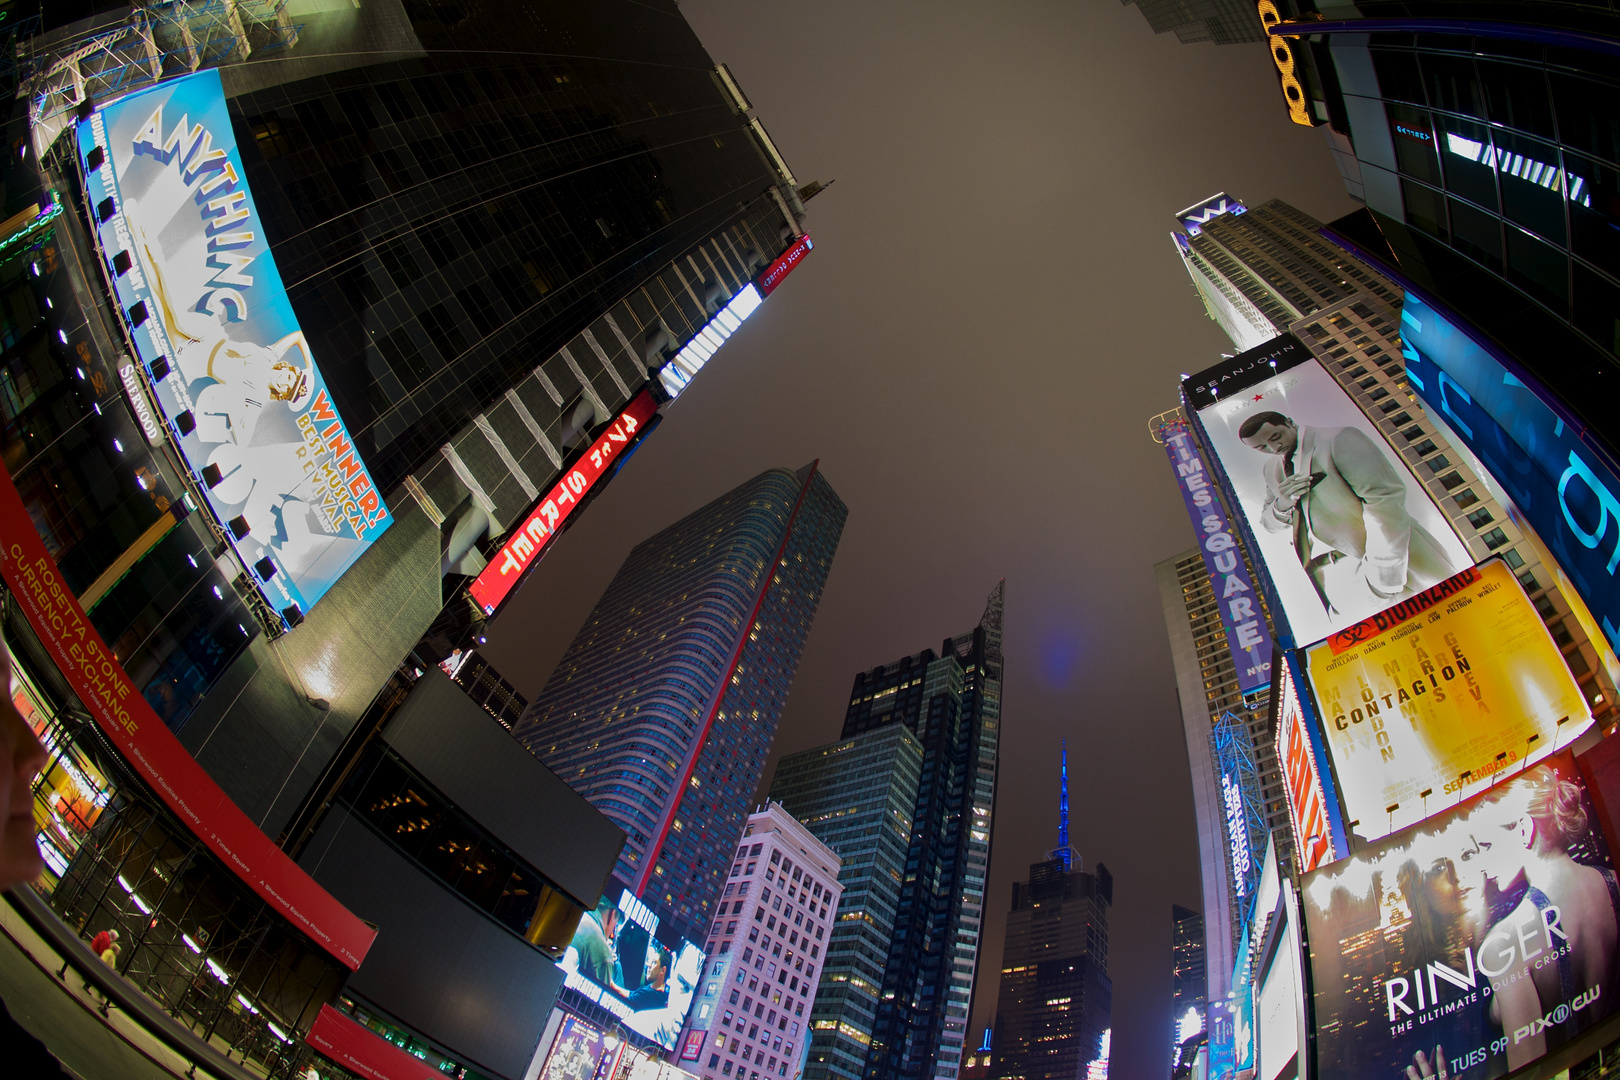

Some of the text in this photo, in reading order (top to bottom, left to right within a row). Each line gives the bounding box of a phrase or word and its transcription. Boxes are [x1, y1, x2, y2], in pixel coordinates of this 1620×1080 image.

[133, 104, 256, 326] ANYTHING
[1185, 199, 1227, 223] W
[119, 363, 159, 442] SHERWOOD
[295, 412, 368, 541] BEST MUSICAL
[295, 446, 346, 534] REVIVAL
[310, 388, 388, 530] WINNER!
[500, 470, 588, 577] STREET
[1201, 513, 1263, 650] SQUARE
[1374, 567, 1476, 632] BIOHAZARD
[1428, 613, 1442, 625] LAW
[1446, 598, 1473, 615] PALTROW
[1477, 582, 1502, 599] WINSLET
[10, 543, 73, 640] CURRENCY
[69, 642, 140, 737] EXCHANGE
[35, 557, 87, 641] ROSETTA
[86, 640, 131, 701] STONE
[1246, 662, 1271, 678] NYC
[1325, 652, 1360, 672] COTILLARD
[1363, 640, 1387, 656] DAMON
[1390, 622, 1424, 643] FISHBURNE
[1408, 633, 1447, 703] PARIS
[1334, 657, 1471, 731] CONTAGION
[1444, 631, 1491, 718] GENEVA
[1356, 674, 1396, 765] LONDON
[18, 580, 40, 616] Sherwood
[37, 613, 56, 642] Equities
[54, 640, 76, 671] Property
[87, 688, 104, 710] Times
[102, 708, 121, 733] Square
[132, 748, 159, 779] Sherwood
[157, 775, 180, 802] Equities
[177, 799, 202, 825] Property
[215, 837, 233, 856] Times
[231, 852, 251, 874] Square
[264, 883, 291, 909] Sherwood
[289, 905, 311, 927] Equities
[309, 923, 332, 943] Property
[345, 950, 361, 965] Times
[1443, 756, 1509, 796] SEPTEMBER
[1509, 750, 1518, 762] 9
[1221, 773, 1245, 897] AMERICAN EAGLE
[1231, 783, 1250, 873] OUTFITTERS
[1385, 904, 1569, 1023] RINGER
[1390, 942, 1573, 1036] THE ULTIMATE DOUBLE CROSS
[1450, 1046, 1487, 1074] TUES
[1490, 1035, 1511, 1056] 9P
